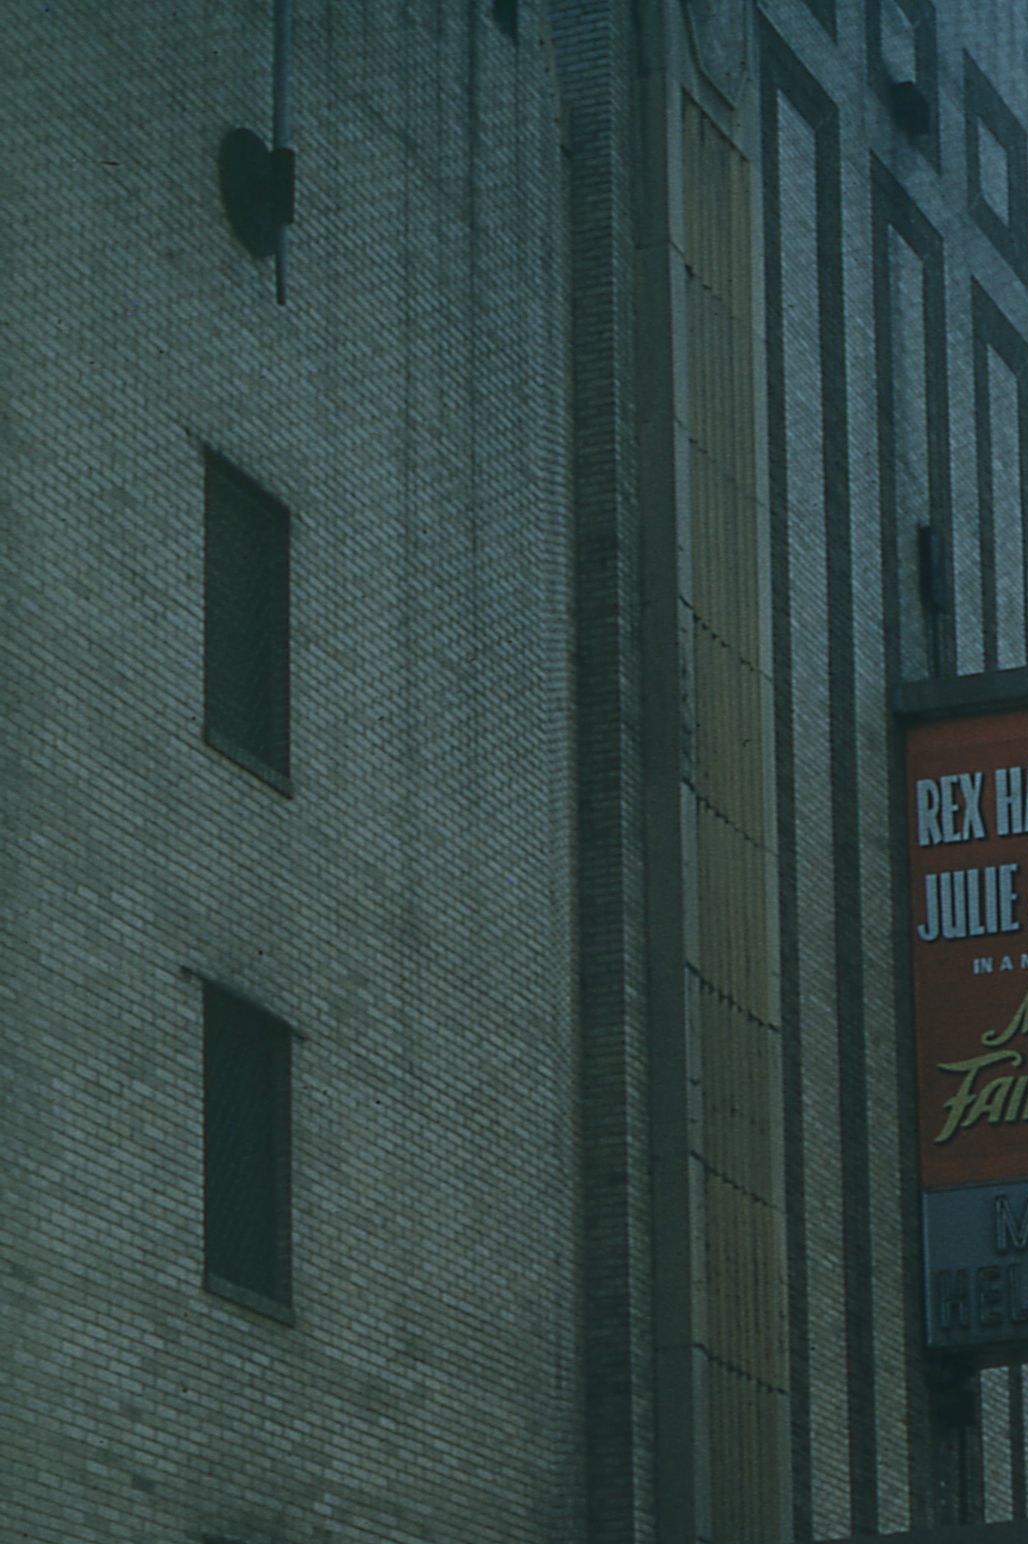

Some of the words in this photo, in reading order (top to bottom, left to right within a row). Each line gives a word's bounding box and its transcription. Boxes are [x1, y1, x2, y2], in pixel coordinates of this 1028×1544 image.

[916, 771, 986, 847] REX
[917, 862, 1021, 943] JULIE
[973, 956, 992, 974] IN
[999, 953, 1014, 971] A
